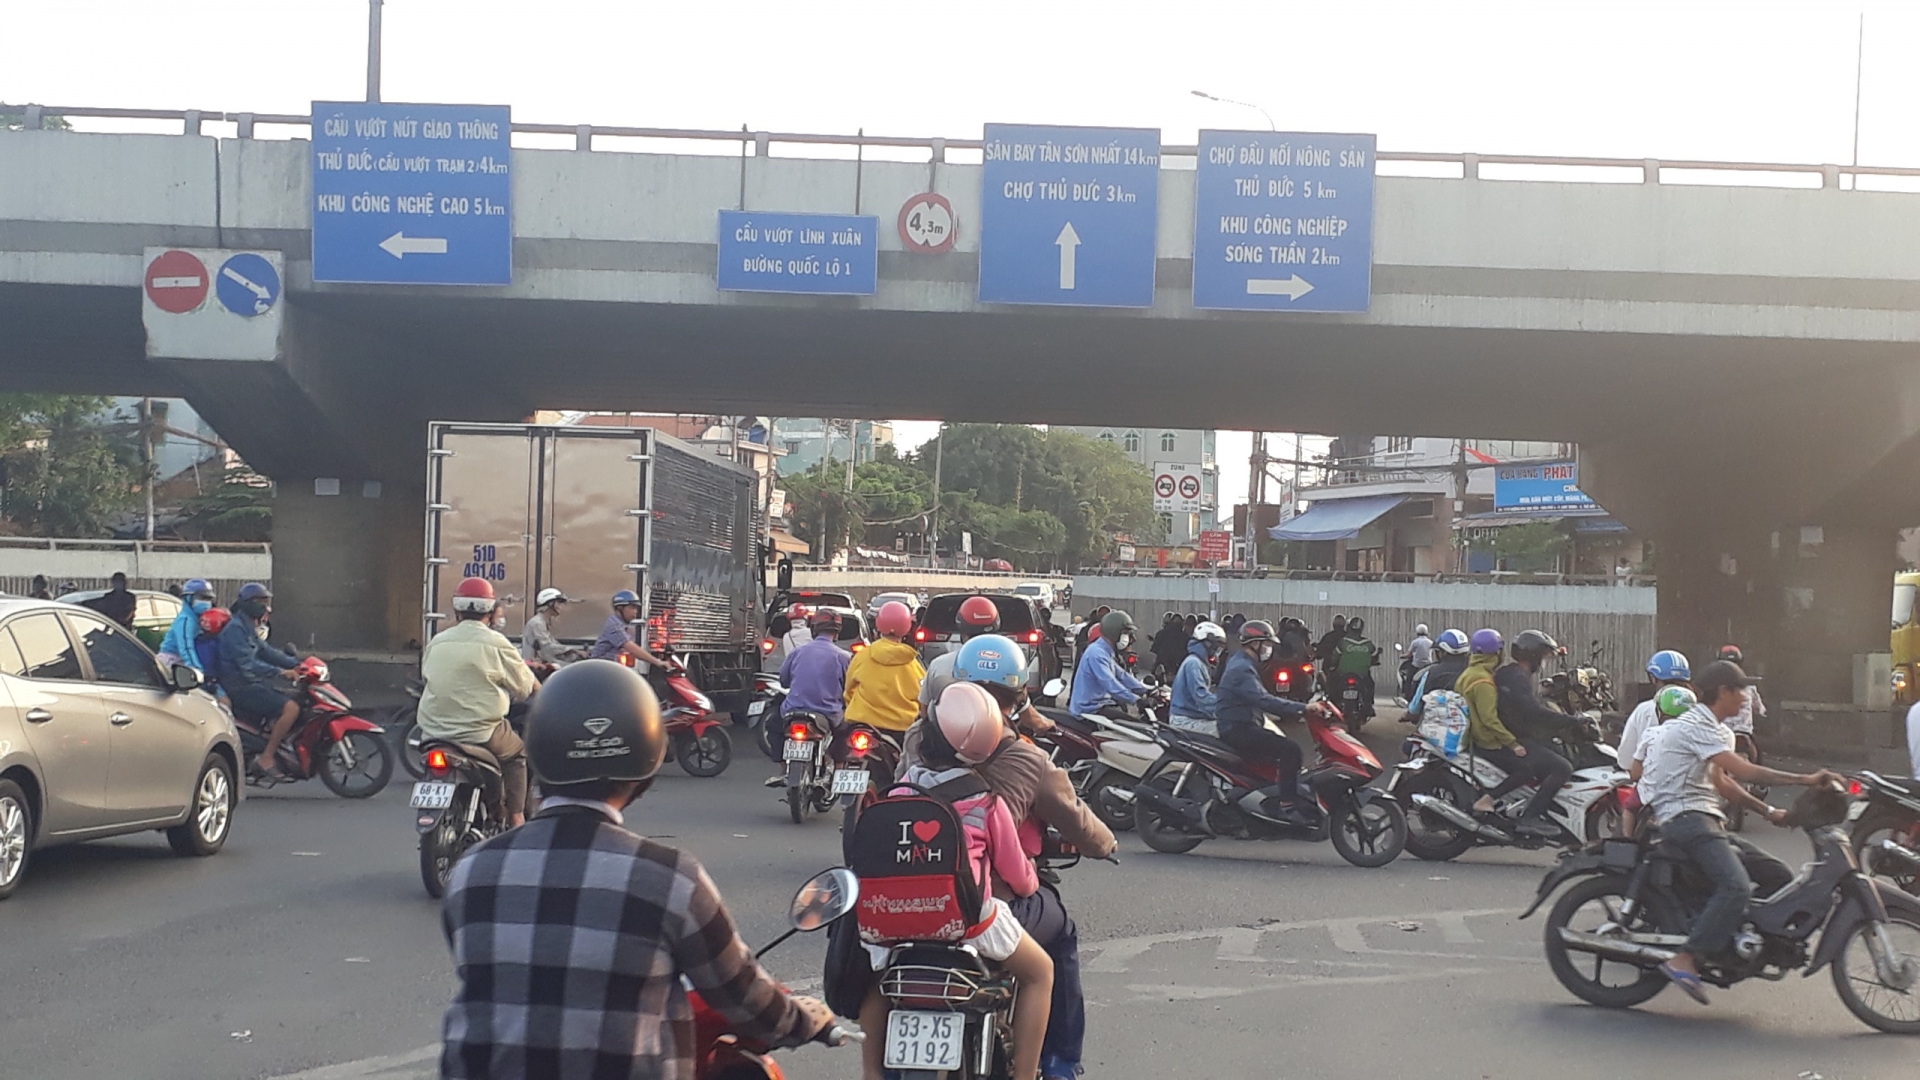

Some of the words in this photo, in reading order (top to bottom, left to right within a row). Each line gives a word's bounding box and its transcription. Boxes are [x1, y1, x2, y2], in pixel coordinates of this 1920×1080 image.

[393, 116, 418, 138] NÚT
[423, 119, 452, 139] GIAO
[457, 119, 499, 140] THÔNG
[318, 147, 342, 171] THỦ
[347, 147, 372, 172] ĐỨC
[404, 156, 431, 174] VƯỢT
[436, 158, 465, 175] TRẠM
[986, 139, 1011, 161] SÂN
[1013, 143, 1036, 162] BAY
[1038, 140, 1061, 163] TÂN
[1064, 143, 1089, 164] SƠN
[1091, 140, 1121, 165] NHẤT
[1209, 144, 1235, 167] CHỢ
[1239, 141, 1264, 165] ĐẦU
[1269, 142, 1290, 166] MỐI
[1296, 145, 1331, 167] NÔNG
[1339, 145, 1365, 168] SẢN
[1003, 181, 1034, 202] CHỢ
[1039, 177, 1067, 201] THỦ
[1073, 177, 1100, 201] ĐỨC
[1235, 174, 1260, 197] THỦ
[1269, 175, 1294, 198] ĐỨC
[318, 194, 346, 213] KHU
[351, 190, 390, 214] CÔNG
[397, 192, 435, 217] NGHỆ
[440, 197, 469, 214] CAO
[735, 221, 758, 242] CẦU
[765, 228, 794, 246] VƯỢT
[832, 228, 862, 246] XUÂN
[1220, 216, 1248, 235] KHU
[1254, 214, 1292, 236] CÔNG
[1297, 215, 1348, 239] NGHIỆP
[1225, 242, 1263, 263] SÓNG
[1269, 240, 1306, 265] THẦN
[743, 253, 783, 274] ĐƯỜNG
[788, 255, 820, 276] QUỐC
[825, 258, 840, 278] LỘ
[845, 262, 851, 275] 1
[473, 544, 496, 562] 51D
[1346, 643, 1369, 653] Grab
[898, 821, 912, 845] I
[899, 1015, 952, 1039] 53-X5
[896, 1041, 950, 1065] 3192
